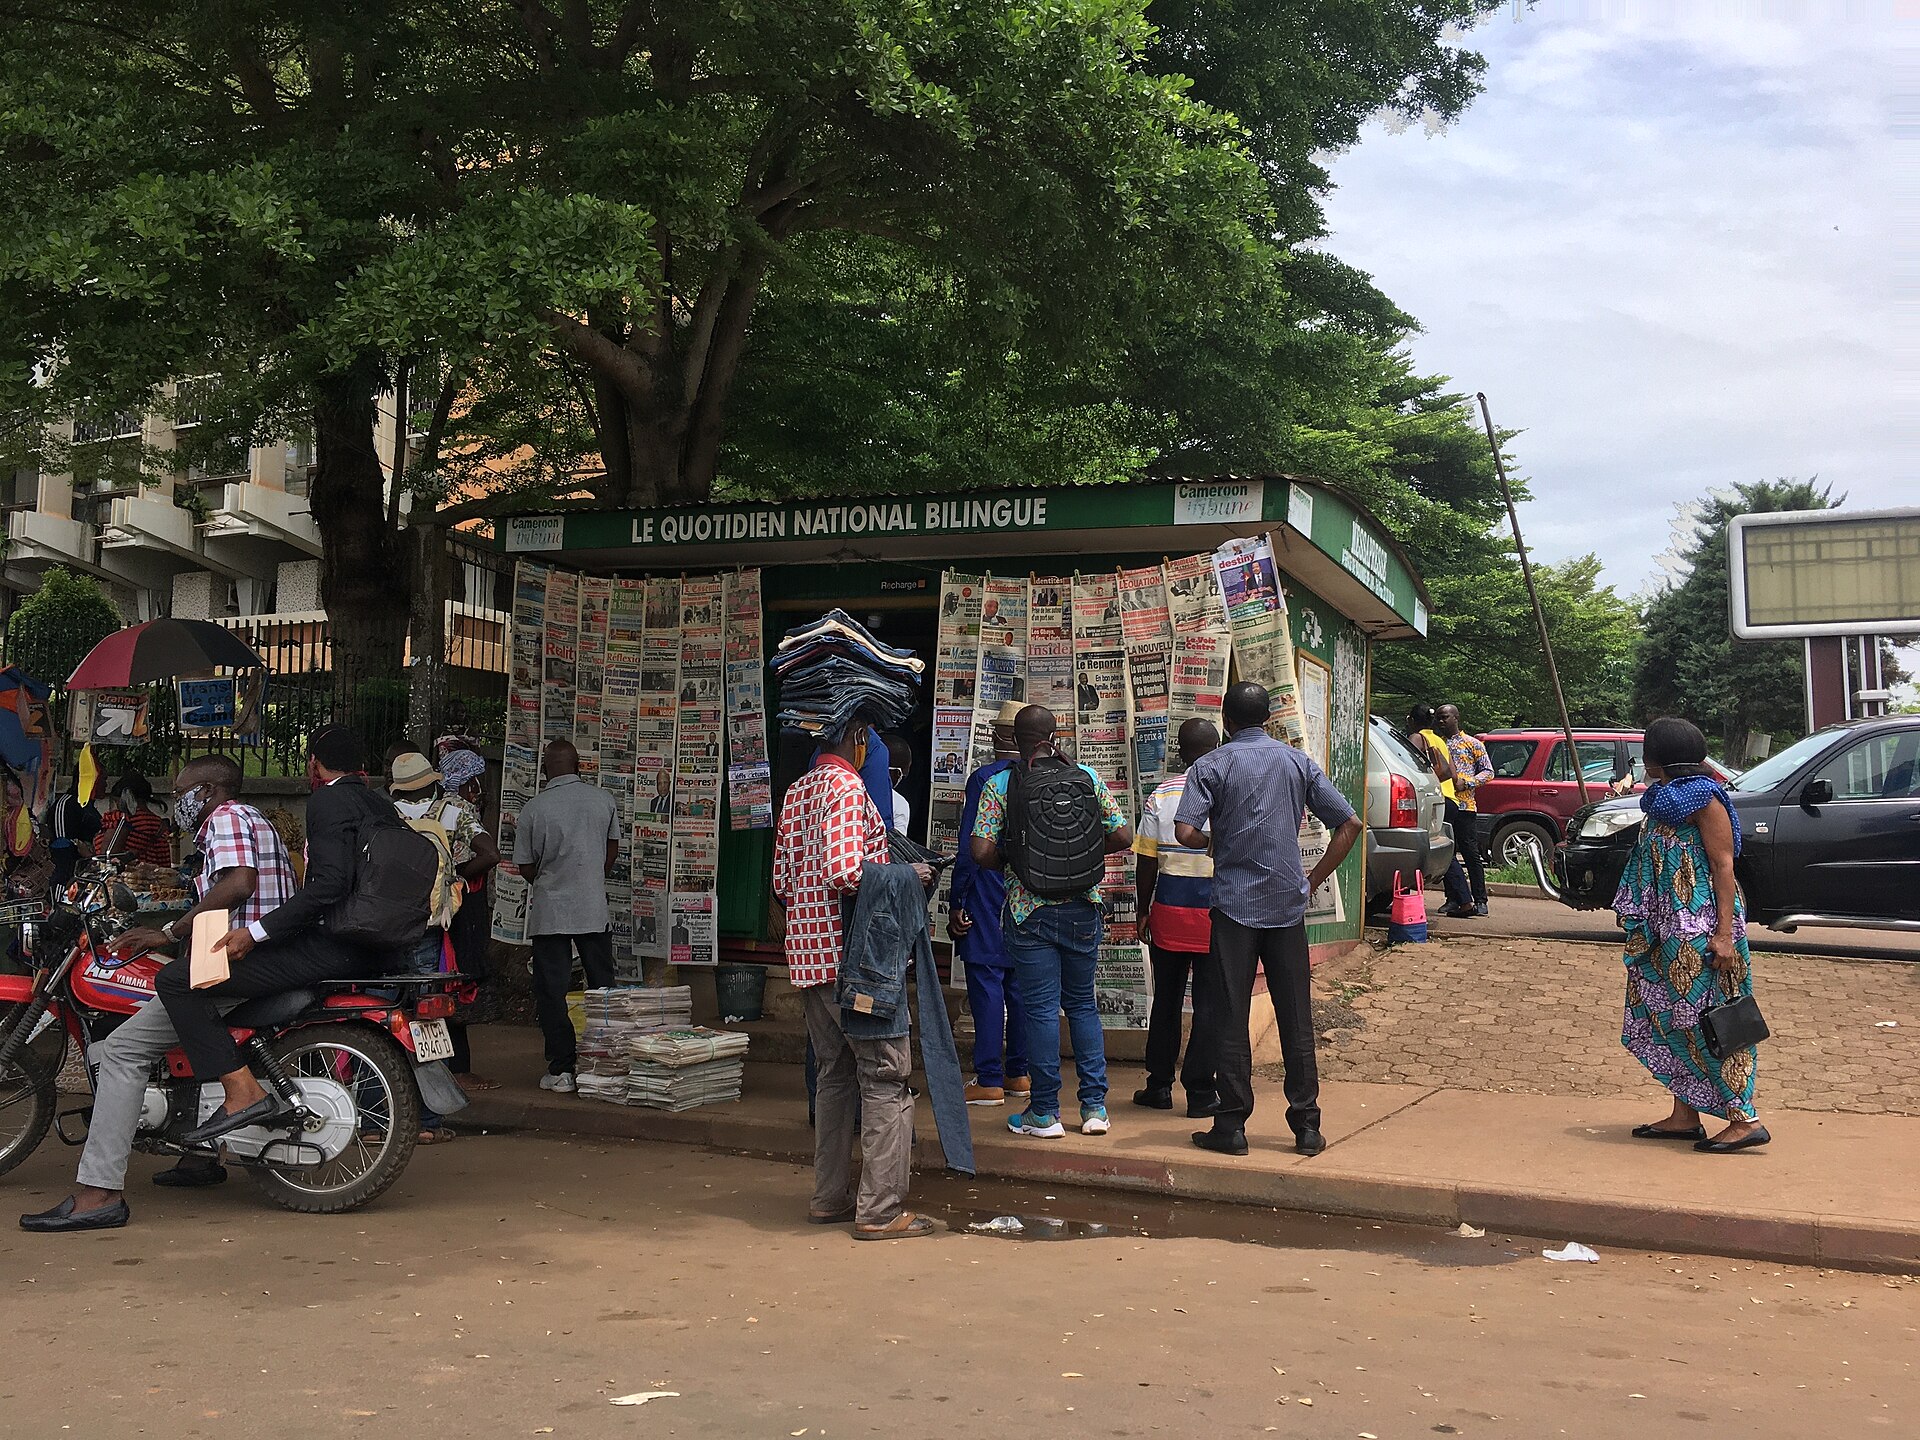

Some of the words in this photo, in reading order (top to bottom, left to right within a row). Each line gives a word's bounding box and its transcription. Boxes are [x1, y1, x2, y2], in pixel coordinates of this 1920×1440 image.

[1179, 485, 1248, 499] Cameroon
[511, 516, 559, 529] Cameroon
[631, 518, 653, 543] LE
[660, 511, 786, 544] QUOTIDIEN
[794, 503, 917, 536] NATIONAL
[925, 498, 1047, 530] BILINGUE
[1218, 552, 1255, 569] destiny
[881, 580, 917, 590] Recharge
[1138, 640, 1173, 654] NOUVELL
[1076, 660, 1085, 670] Le
[1087, 658, 1124, 670] Reporter
[116, 974, 148, 989] YAMAHA
[418, 1040, 443, 1059] 3940
